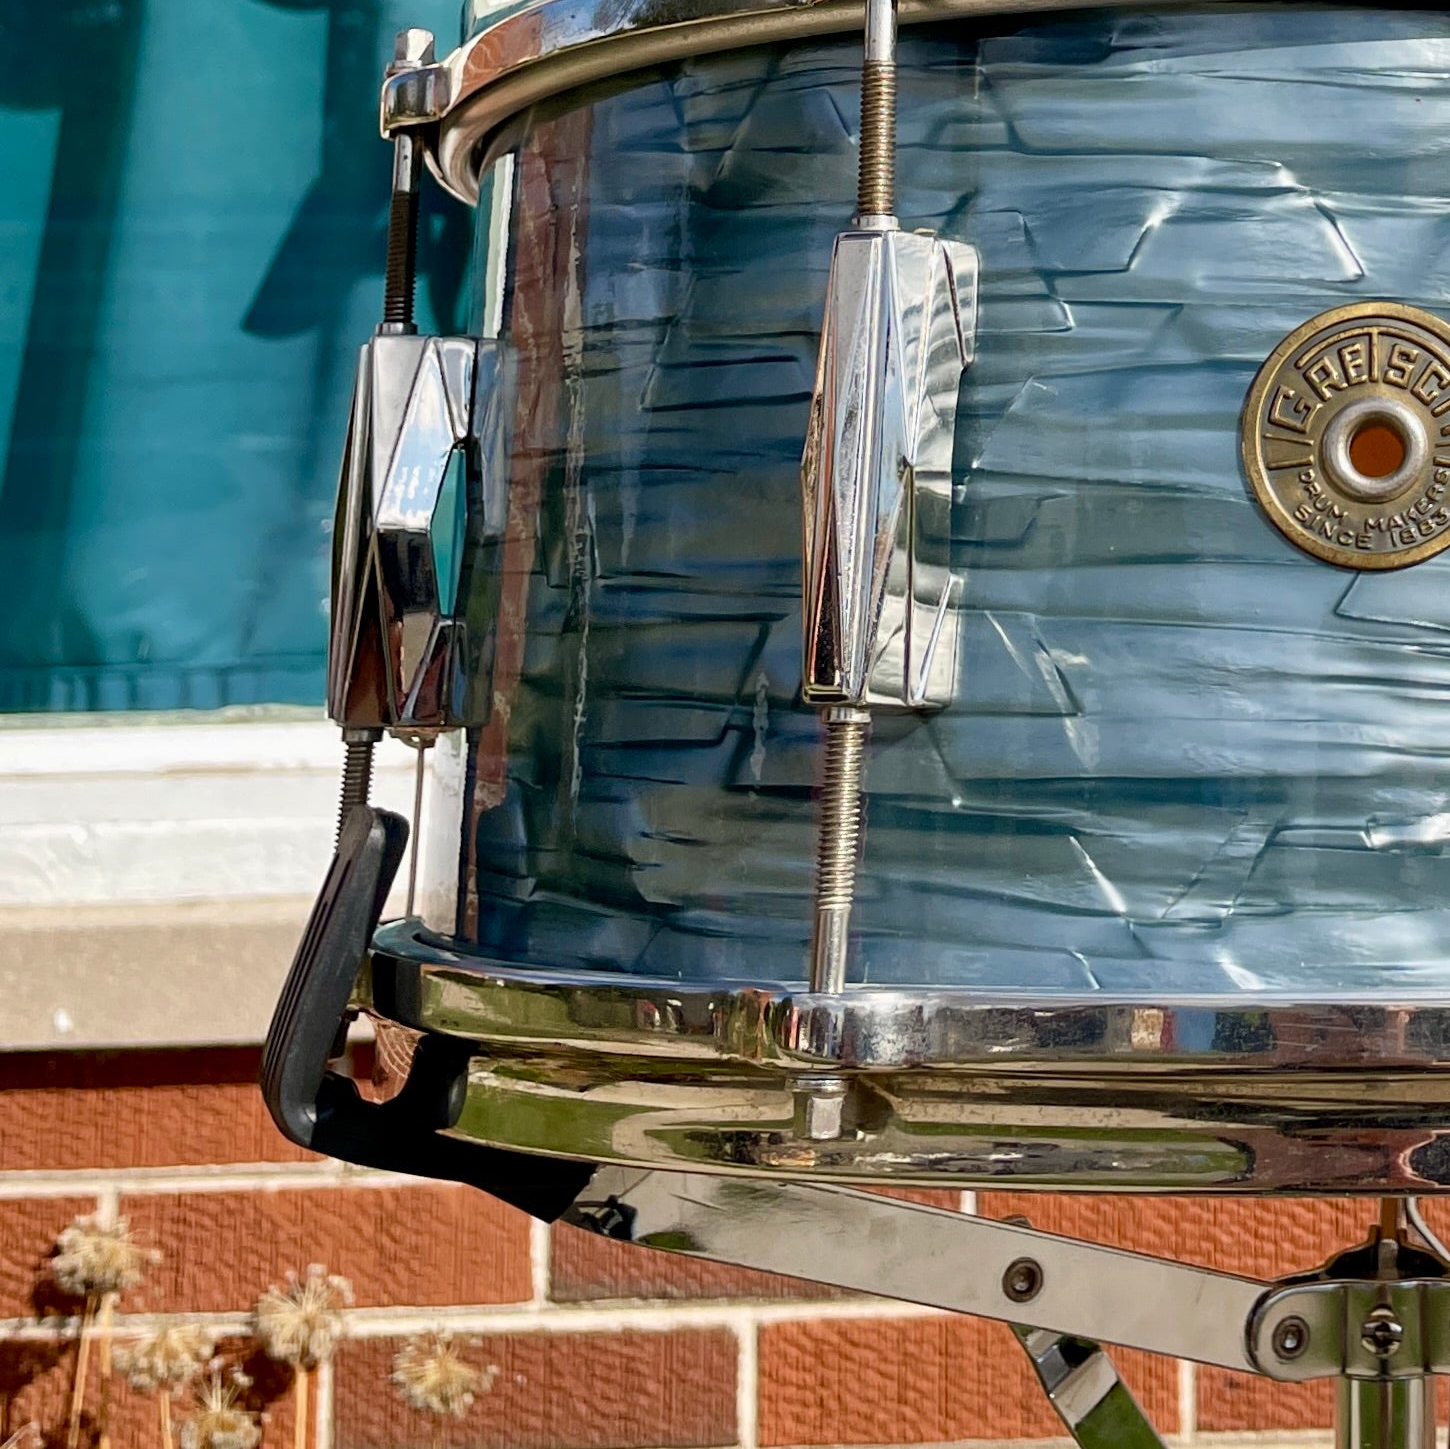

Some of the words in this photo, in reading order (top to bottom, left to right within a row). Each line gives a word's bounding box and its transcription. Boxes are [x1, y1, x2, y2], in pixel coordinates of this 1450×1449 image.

[1294, 503, 1373, 550] SINCE
[1389, 506, 1450, 548] 1883
[1298, 468, 1349, 525] DRUM
[1363, 468, 1450, 534] MAKERS
